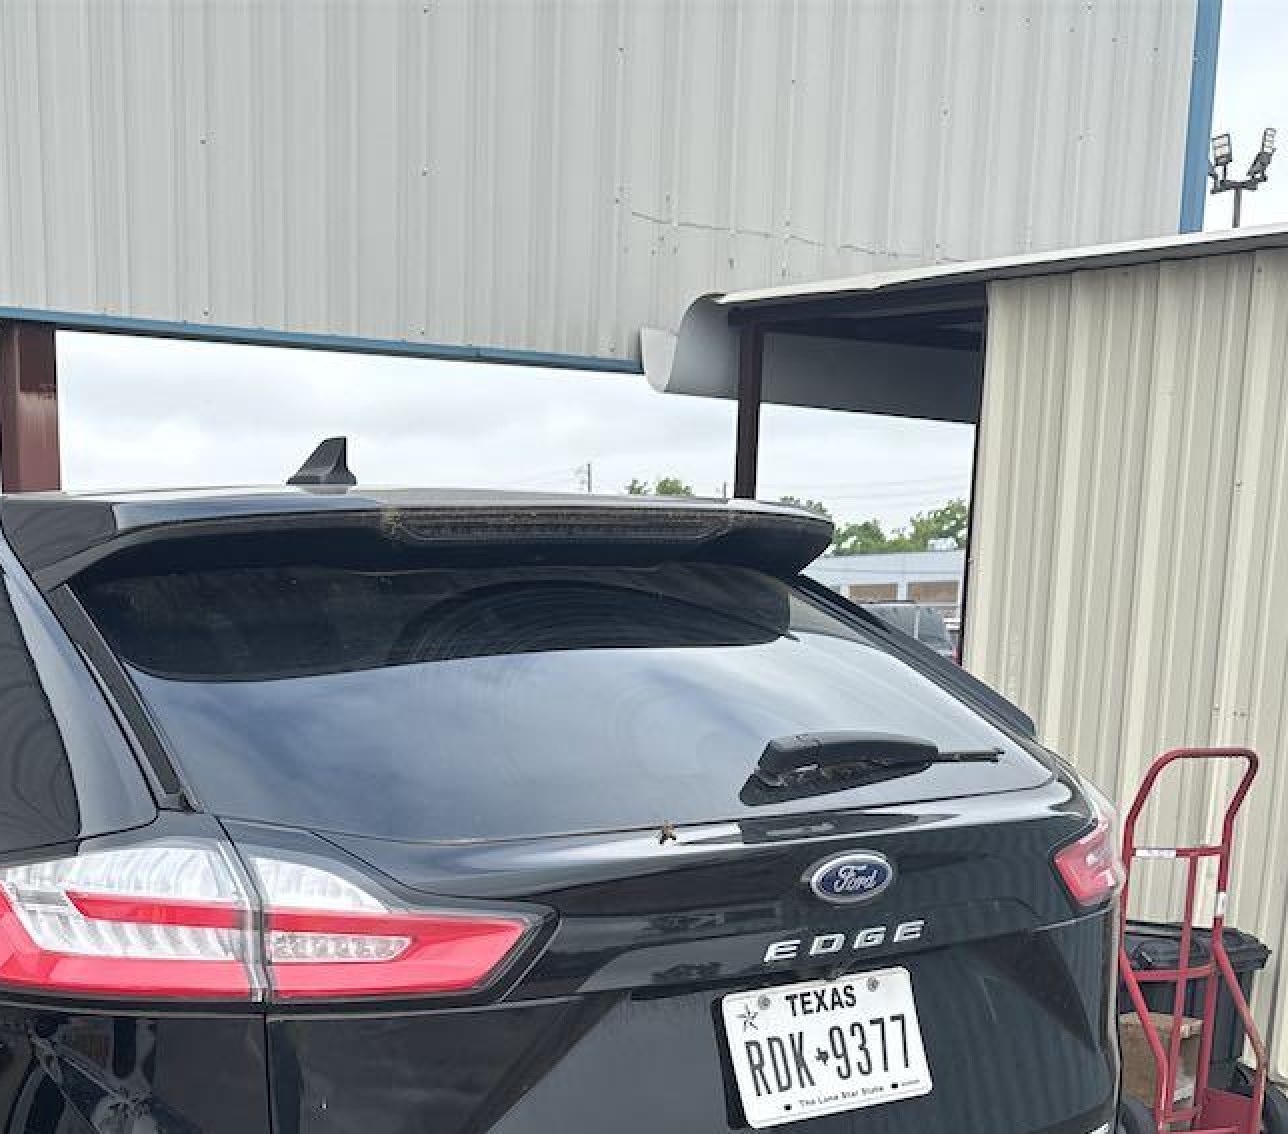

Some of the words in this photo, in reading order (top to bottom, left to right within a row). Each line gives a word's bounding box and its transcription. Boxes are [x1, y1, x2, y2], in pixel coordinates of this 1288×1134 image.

[833, 864, 880, 893] Ford
[764, 919, 925, 963] EDGE
[785, 985, 857, 1017] TEXAS
[744, 1031, 816, 1097] RDK
[828, 1013, 910, 1080] 9377
